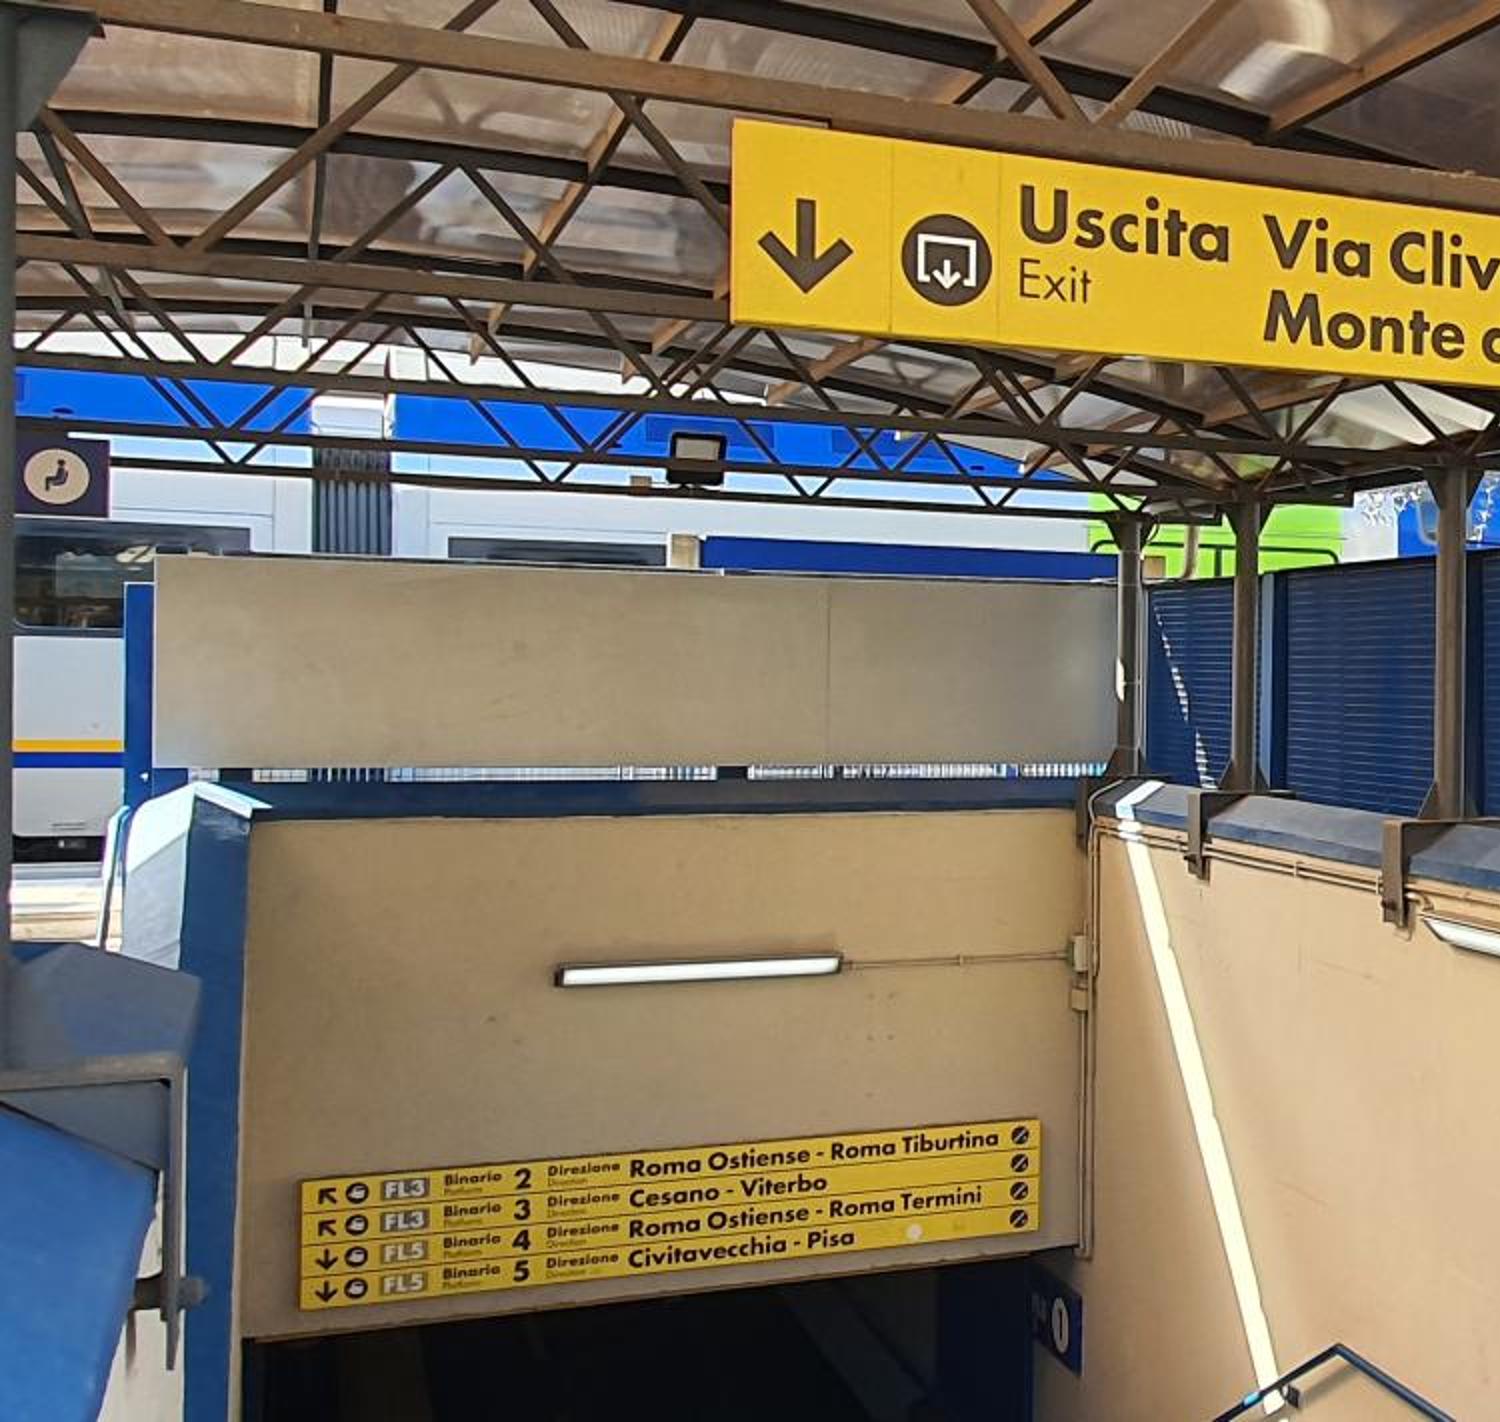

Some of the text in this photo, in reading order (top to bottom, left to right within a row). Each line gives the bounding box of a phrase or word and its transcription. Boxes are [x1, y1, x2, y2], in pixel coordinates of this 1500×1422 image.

[1019, 184, 1230, 263] Uscita
[1262, 214, 1371, 278] Via
[1018, 257, 1093, 305] Exit
[1262, 288, 1466, 360] Monte
[383, 1178, 426, 1200] FL3
[444, 1170, 503, 1187] Binario
[513, 1167, 532, 1190] 2
[547, 1161, 621, 1178] Direzione
[629, 1158, 702, 1179] Roma
[707, 1146, 811, 1171] Ostiense
[830, 1142, 897, 1161] Roma
[901, 1130, 1000, 1154] Tiburtina
[383, 1209, 425, 1232] FL3
[443, 1202, 503, 1218] Binario
[513, 1199, 531, 1221] 3
[547, 1192, 621, 1208] Direzione
[629, 1187, 720, 1208] Cesano
[740, 1173, 827, 1197] Viterbo
[383, 1241, 425, 1264] FL5
[443, 1233, 502, 1250] Binario
[511, 1229, 531, 1251] 4
[547, 1223, 620, 1239] Direzione
[629, 1219, 701, 1239] Roma
[707, 1207, 810, 1231] Ostiense
[829, 1199, 896, 1218] Roma
[900, 1185, 982, 1211] Termini
[383, 1272, 424, 1295] FL5
[442, 1263, 501, 1281] Binario
[512, 1259, 530, 1283] 5
[546, 1252, 619, 1269] Direzione
[628, 1235, 787, 1268] Civitavecchia
[807, 1229, 855, 1249] Pisa
